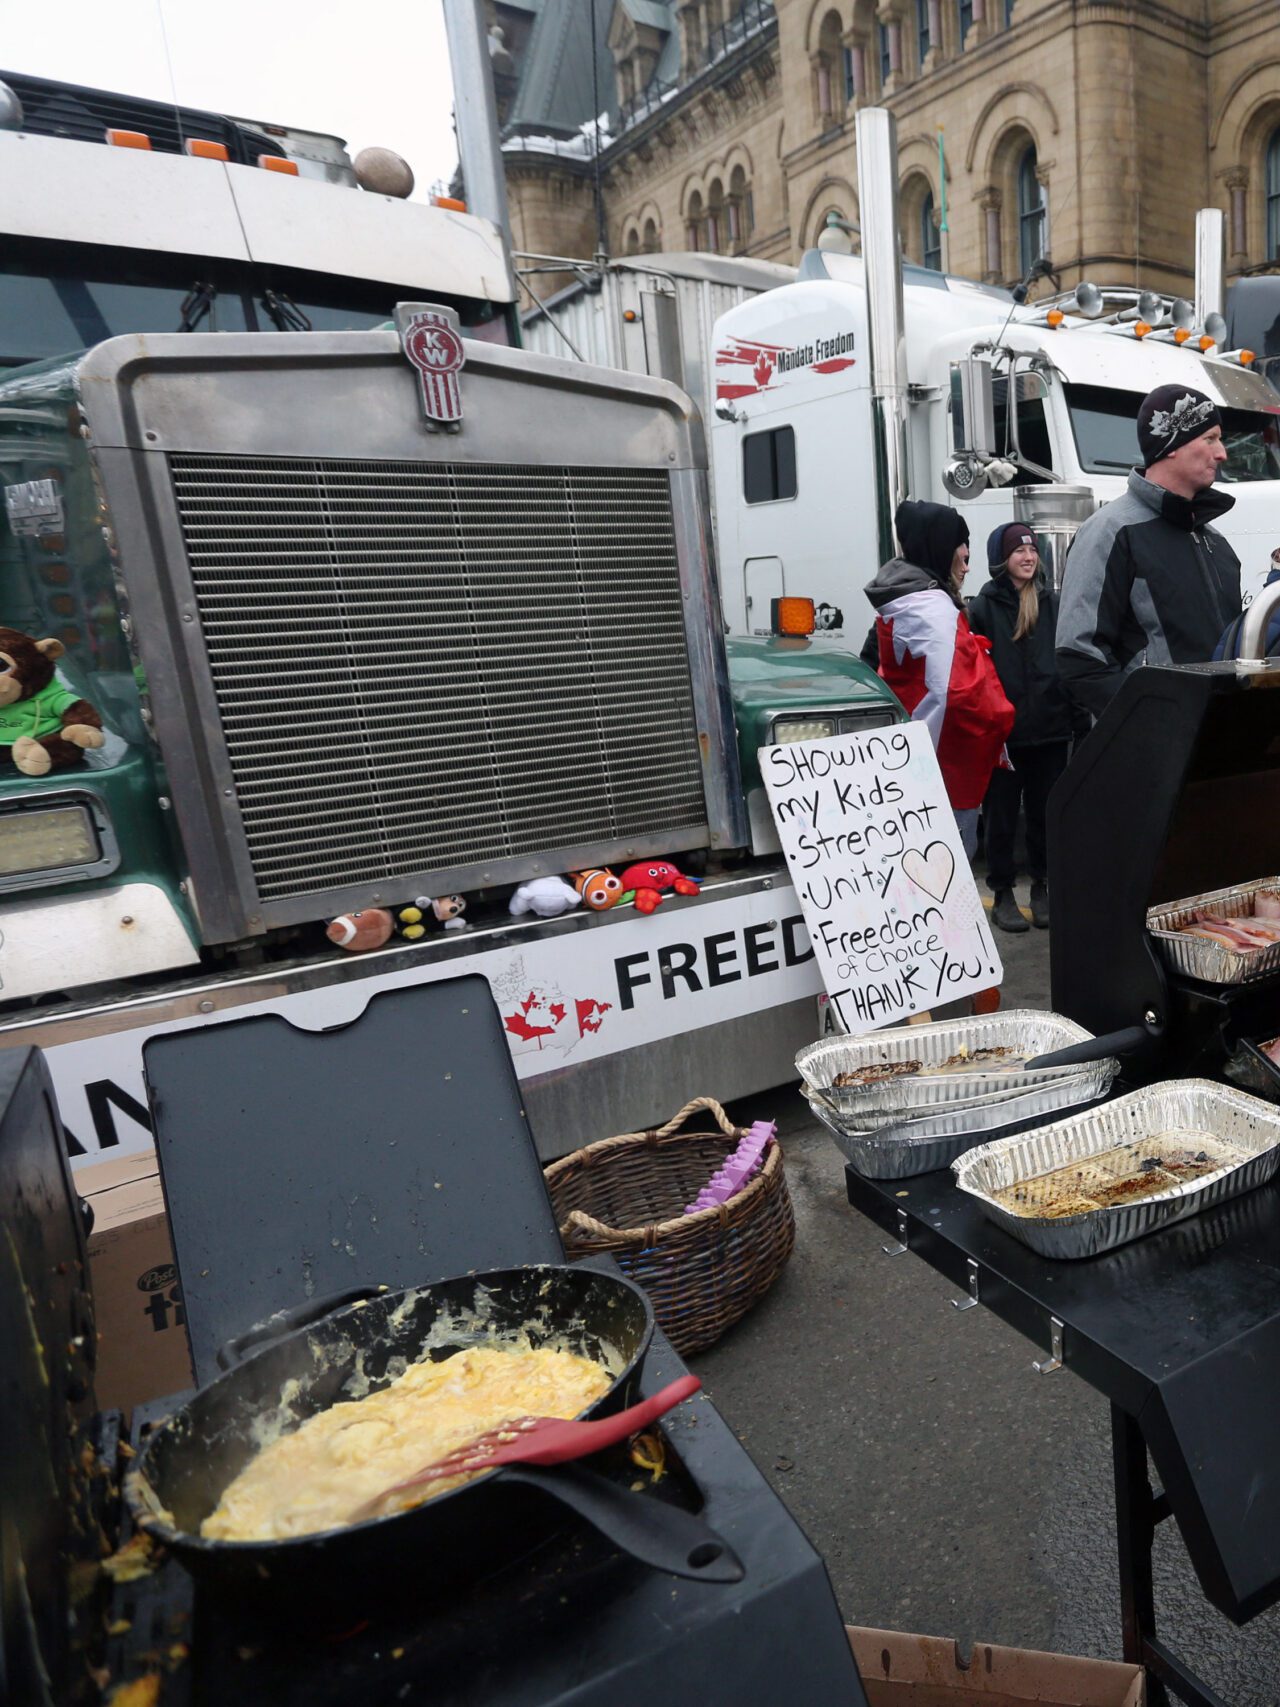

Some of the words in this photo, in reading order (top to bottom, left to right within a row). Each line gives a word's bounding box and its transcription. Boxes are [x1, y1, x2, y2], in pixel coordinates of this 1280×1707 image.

[778, 345, 813, 374] Mandate
[816, 332, 855, 362] Freedom
[777, 790, 819, 829] my
[829, 966, 929, 1034] THANK
